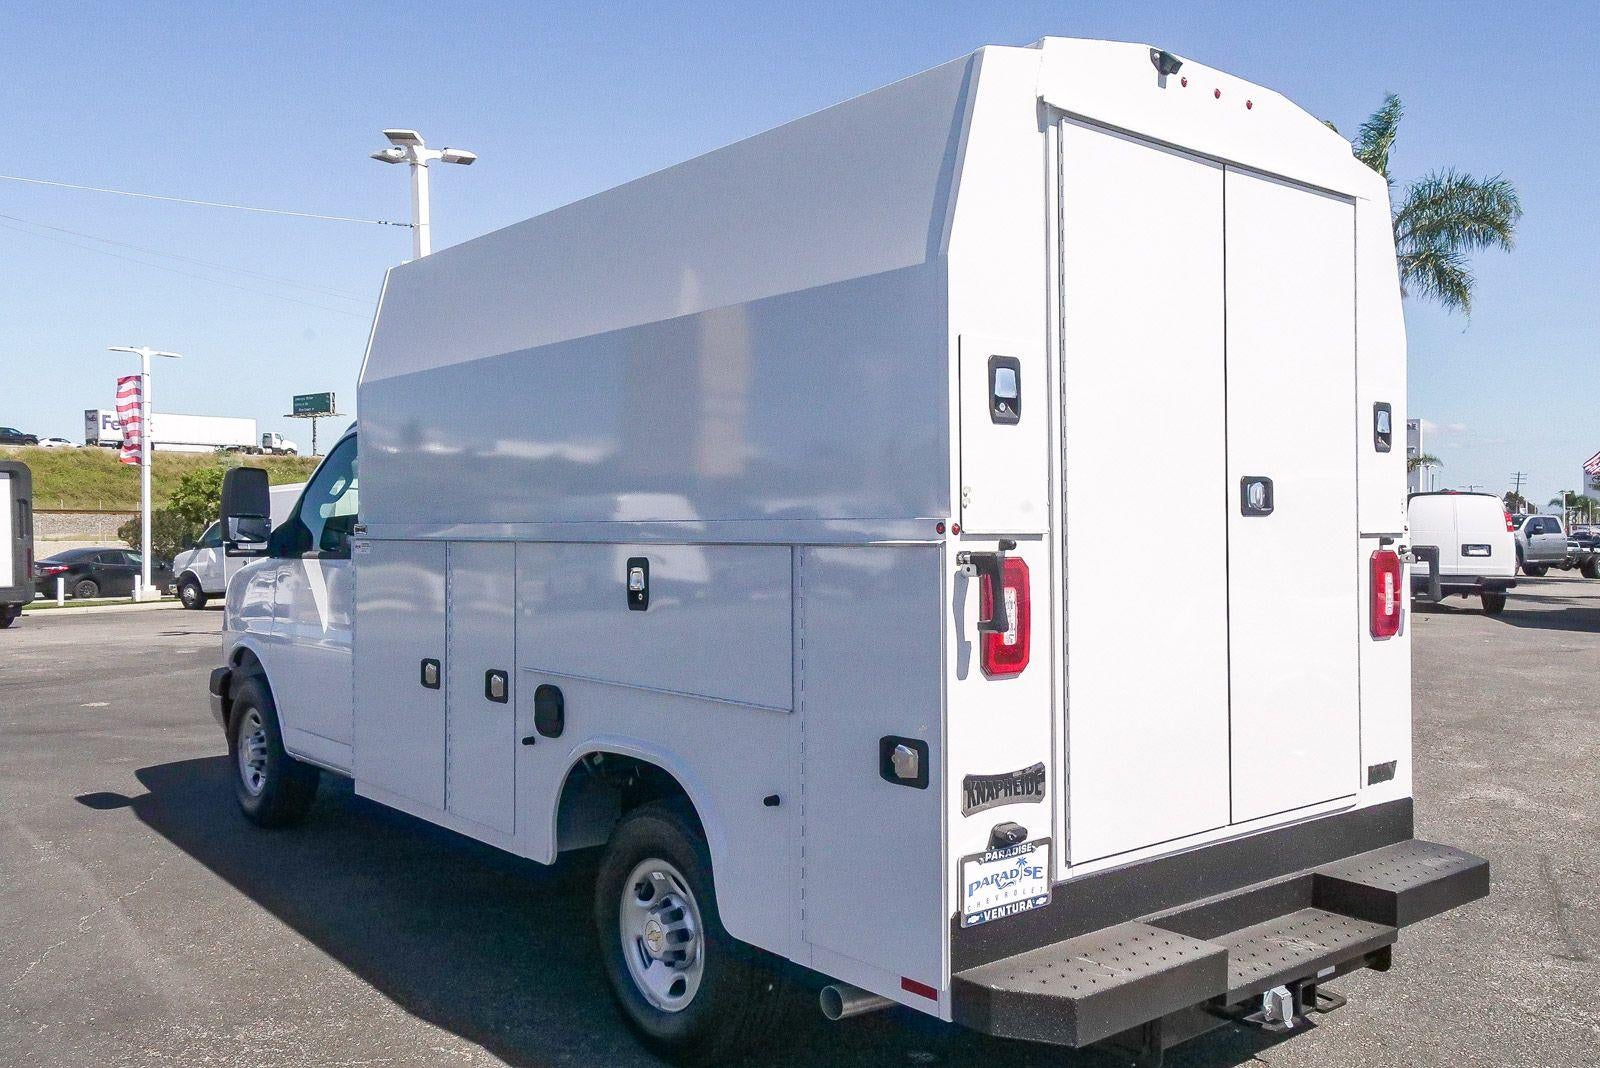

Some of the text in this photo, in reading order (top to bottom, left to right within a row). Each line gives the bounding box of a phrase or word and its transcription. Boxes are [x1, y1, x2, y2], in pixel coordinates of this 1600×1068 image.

[985, 842, 1032, 862] PARADISE
[968, 864, 1043, 897] PARADISE
[967, 886, 1043, 912] CHEVROLET
[983, 899, 1034, 921] VENTURA
